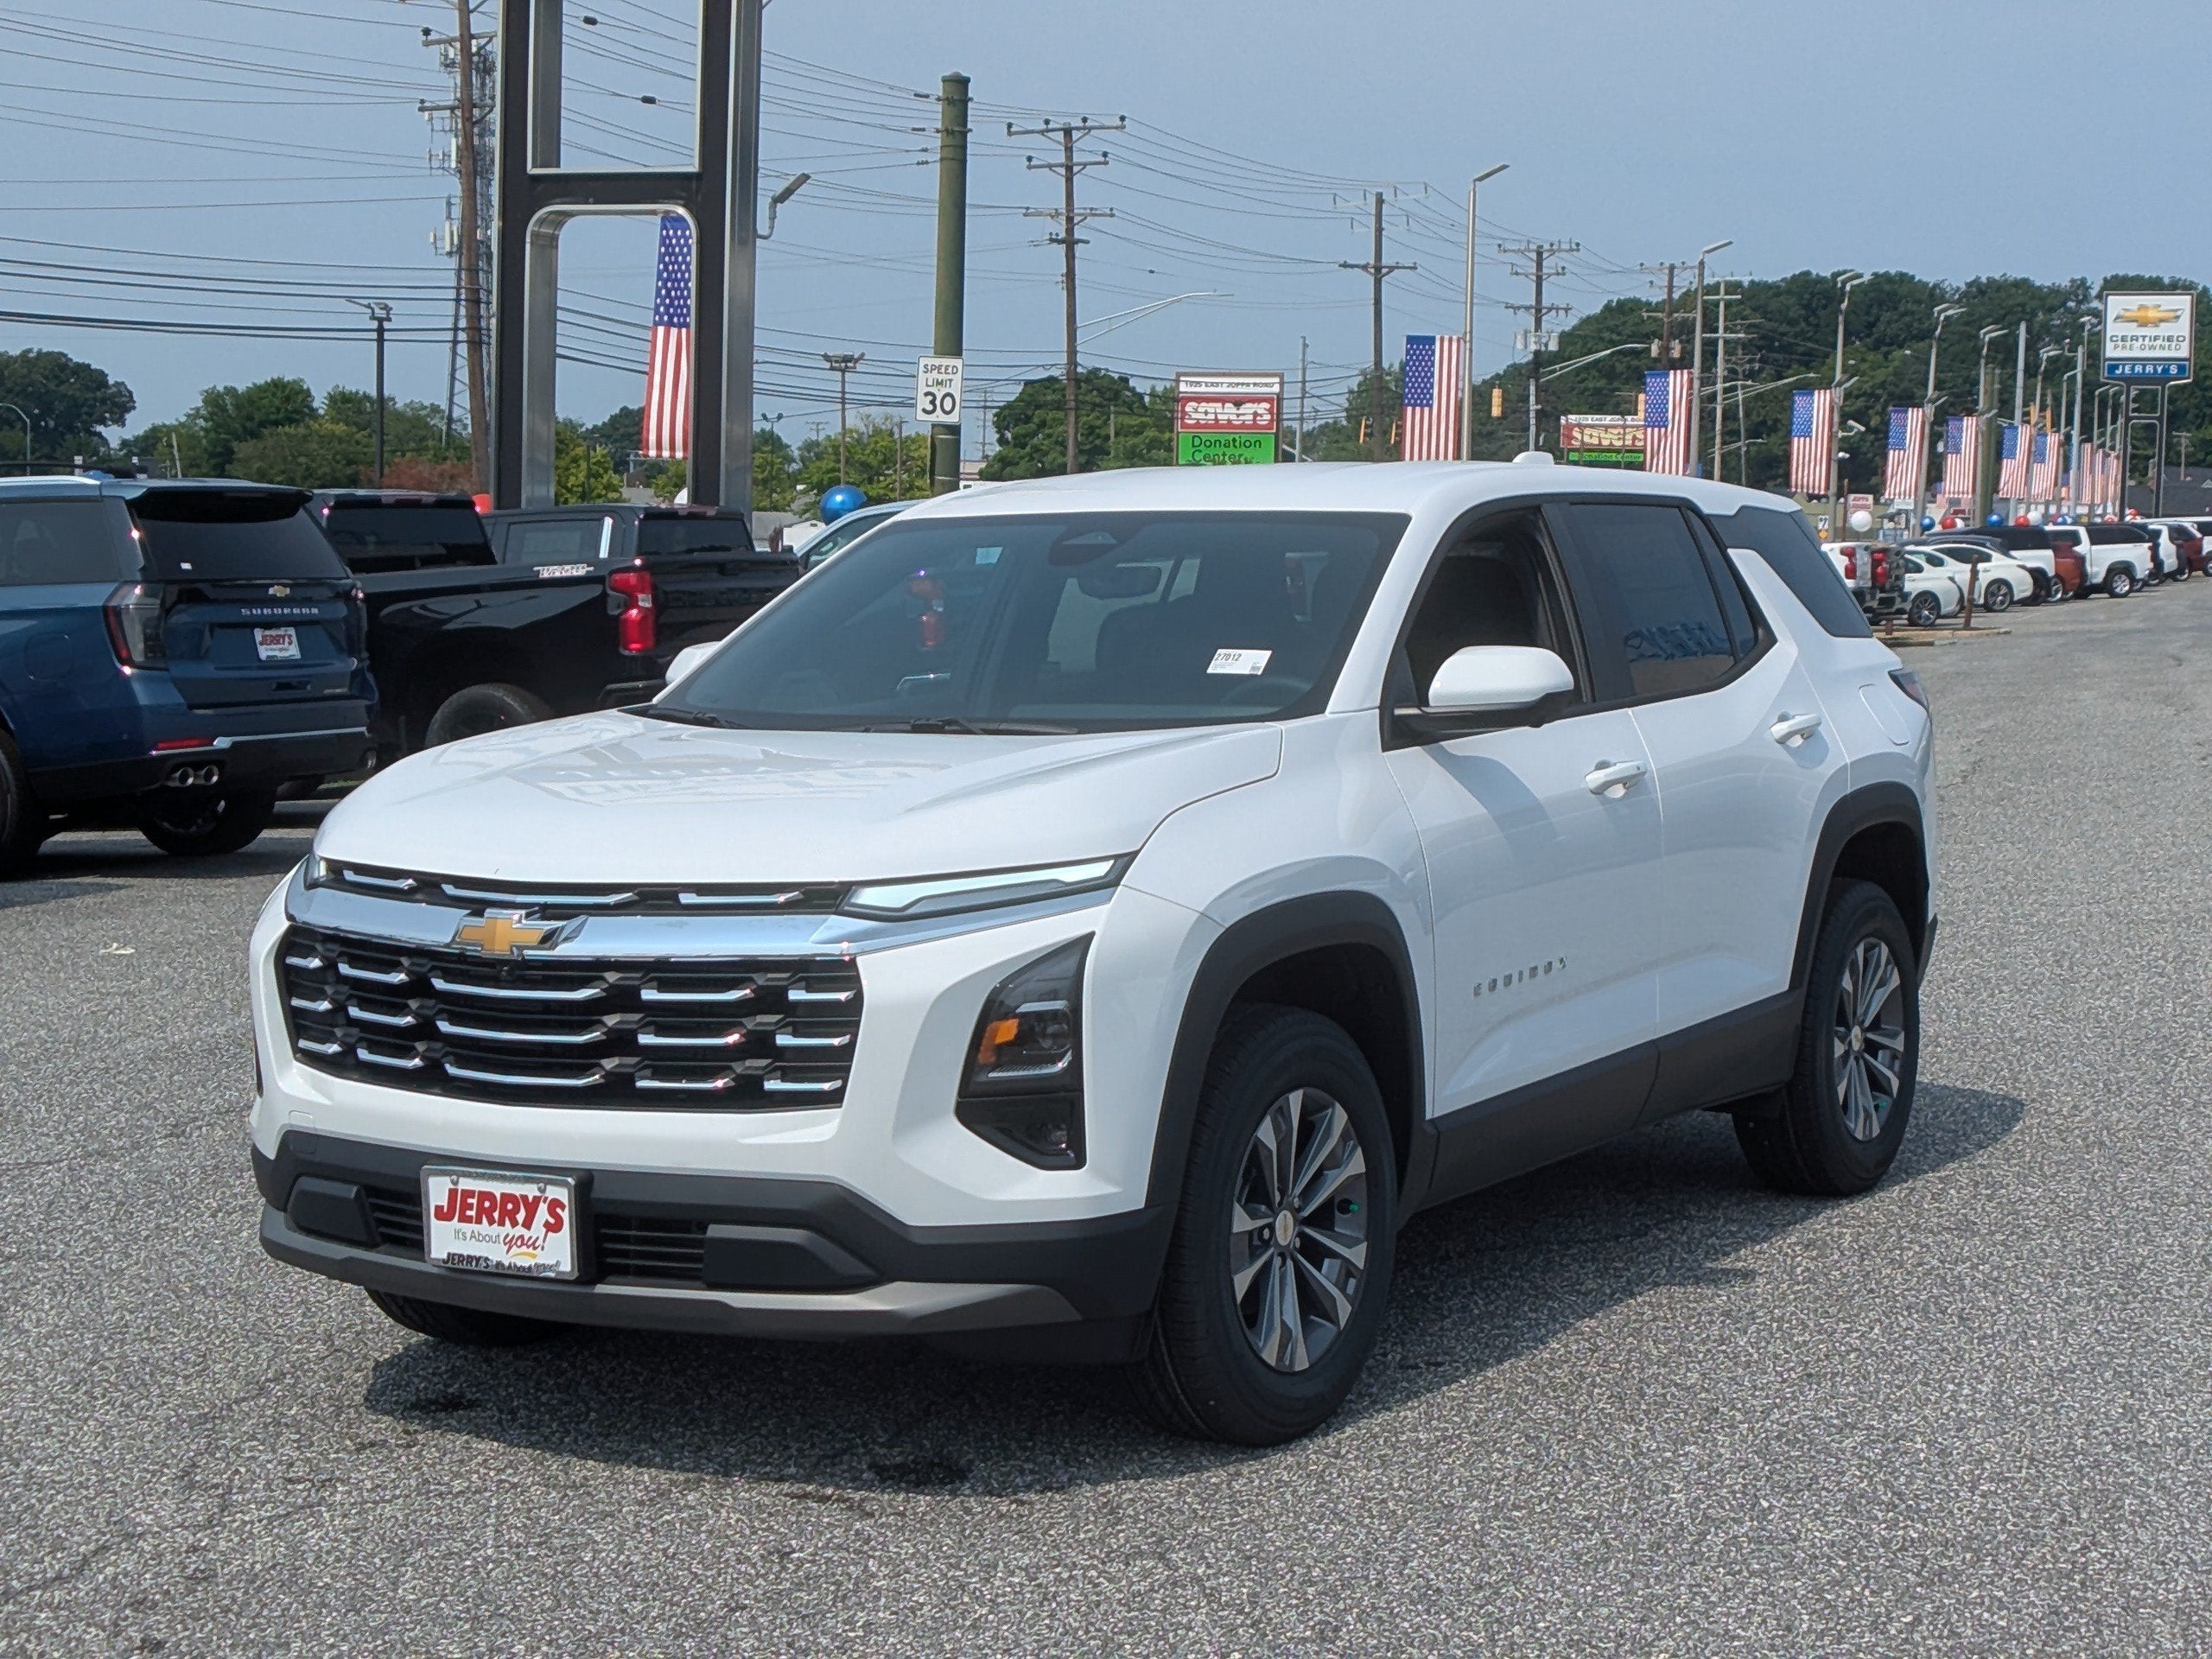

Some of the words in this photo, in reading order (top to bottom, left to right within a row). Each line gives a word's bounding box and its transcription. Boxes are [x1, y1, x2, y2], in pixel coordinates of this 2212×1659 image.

[2109, 334, 2186, 343] CERTIFIED
[2113, 343, 2182, 352] PRE-OWNED
[922, 364, 958, 375] SPEED
[2114, 364, 2177, 374] JERRY'S
[925, 377, 953, 388] LIMIT
[921, 391, 957, 416] 30
[1192, 435, 1262, 449] Donation
[1214, 652, 1243, 662] 27012
[434, 1187, 567, 1234] JERRY'S
[454, 1228, 467, 1241] It's
[469, 1232, 500, 1244] About
[502, 1230, 549, 1255] you!
